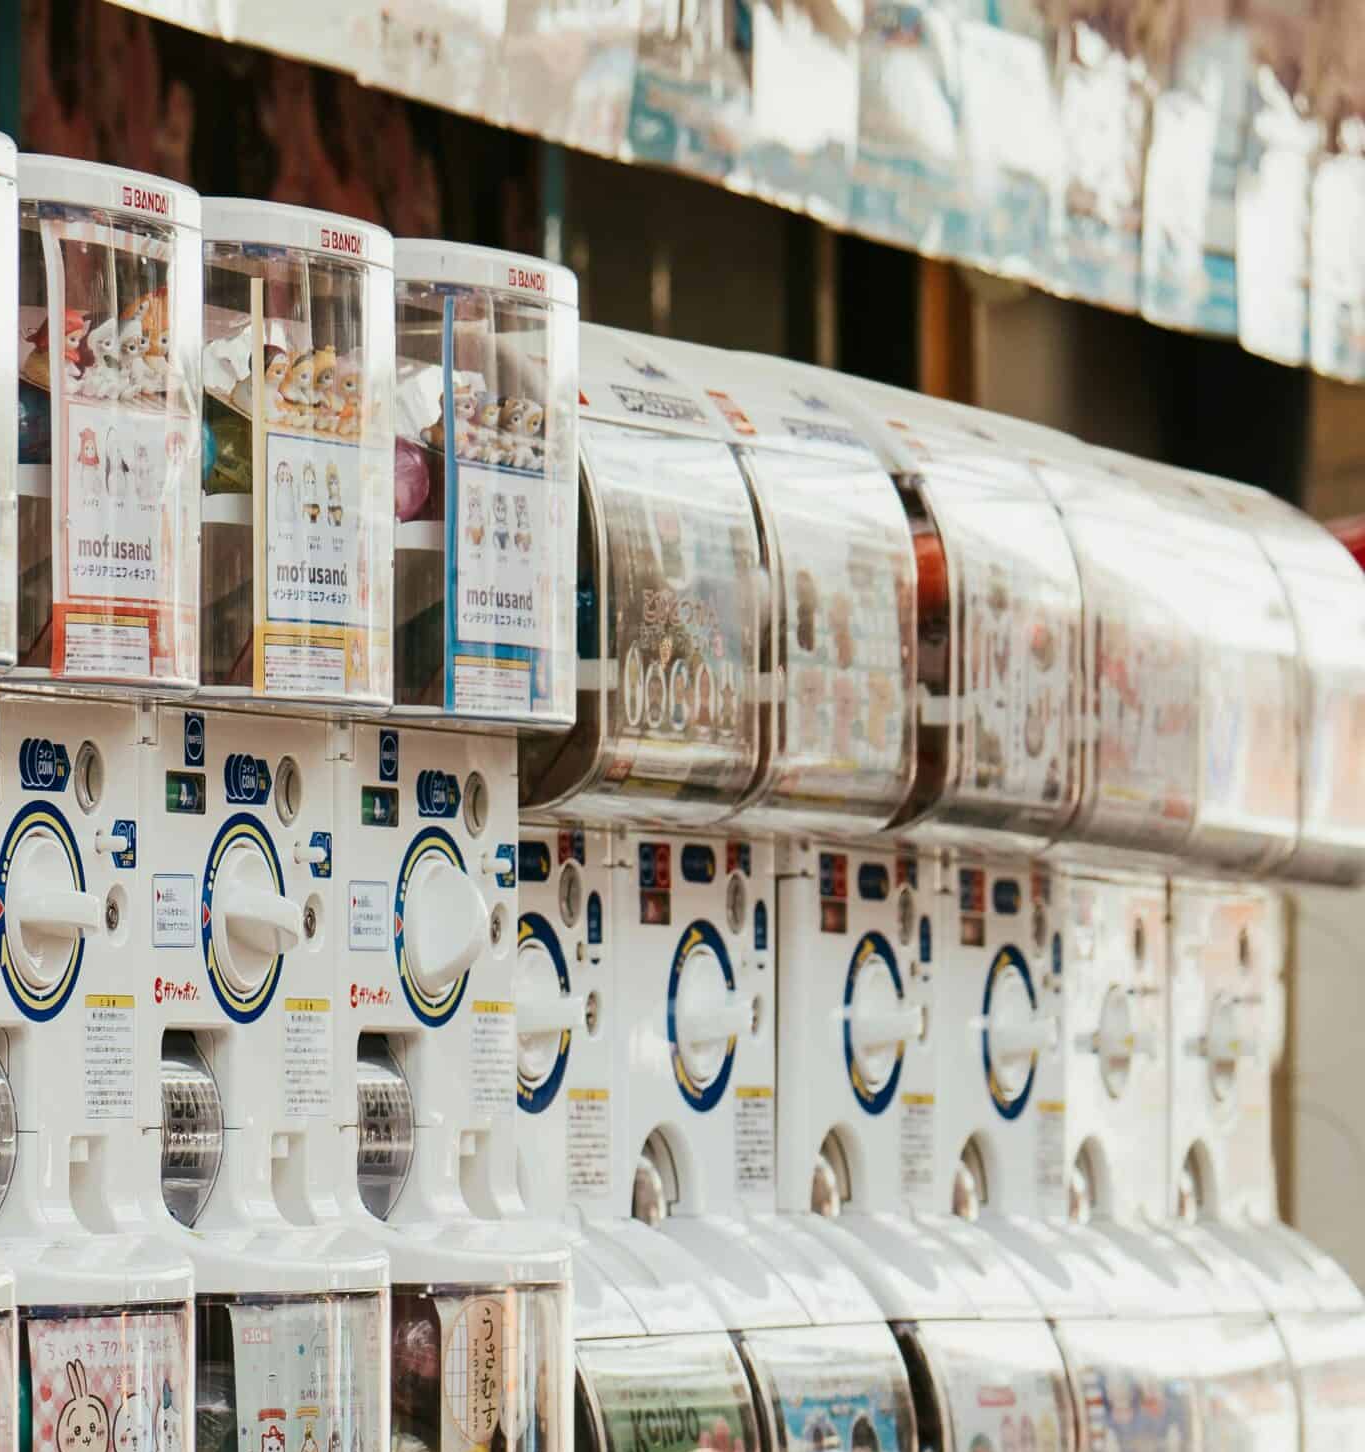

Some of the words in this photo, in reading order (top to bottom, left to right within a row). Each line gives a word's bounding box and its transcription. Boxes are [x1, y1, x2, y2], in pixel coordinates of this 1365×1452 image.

[332, 231, 363, 256] BANDA
[78, 533, 152, 562] mofusand
[276, 560, 348, 587] mofusand
[467, 585, 533, 611] mofusand
[37, 761, 53, 775] COIN
[241, 775, 256, 789] COIN
[163, 981, 198, 1002] ガシャポン
[358, 986, 391, 1005] ガシャポン
